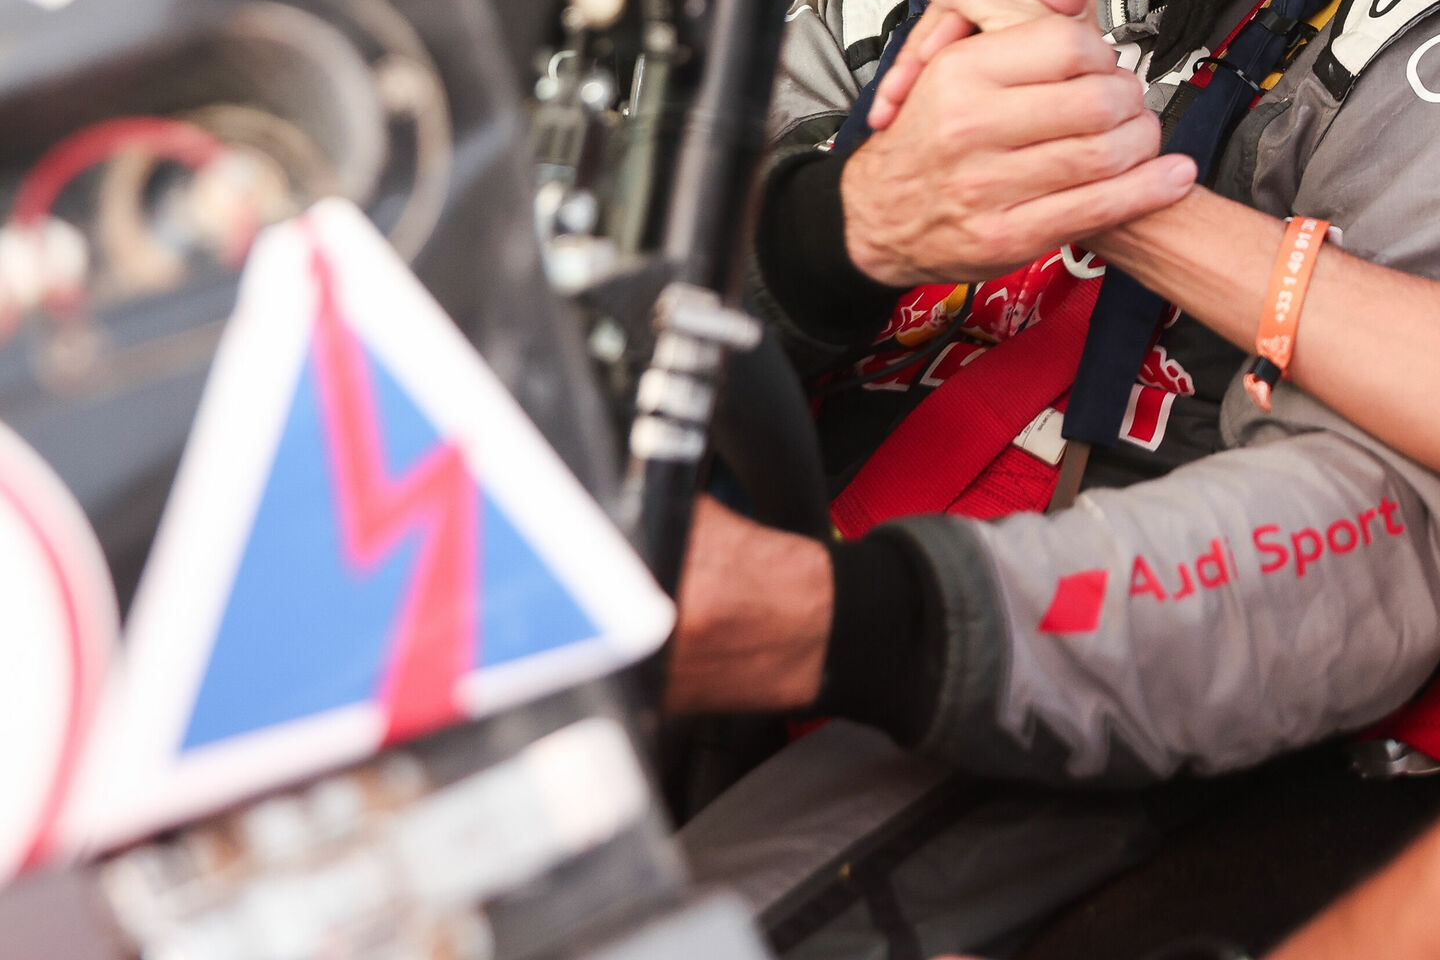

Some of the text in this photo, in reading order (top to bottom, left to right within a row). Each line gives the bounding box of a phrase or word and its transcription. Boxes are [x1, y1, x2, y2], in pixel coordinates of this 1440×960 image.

[1275, 290, 1293, 323] +33
[1287, 251, 1305, 275] 40
[1252, 496, 1405, 579] Sport
